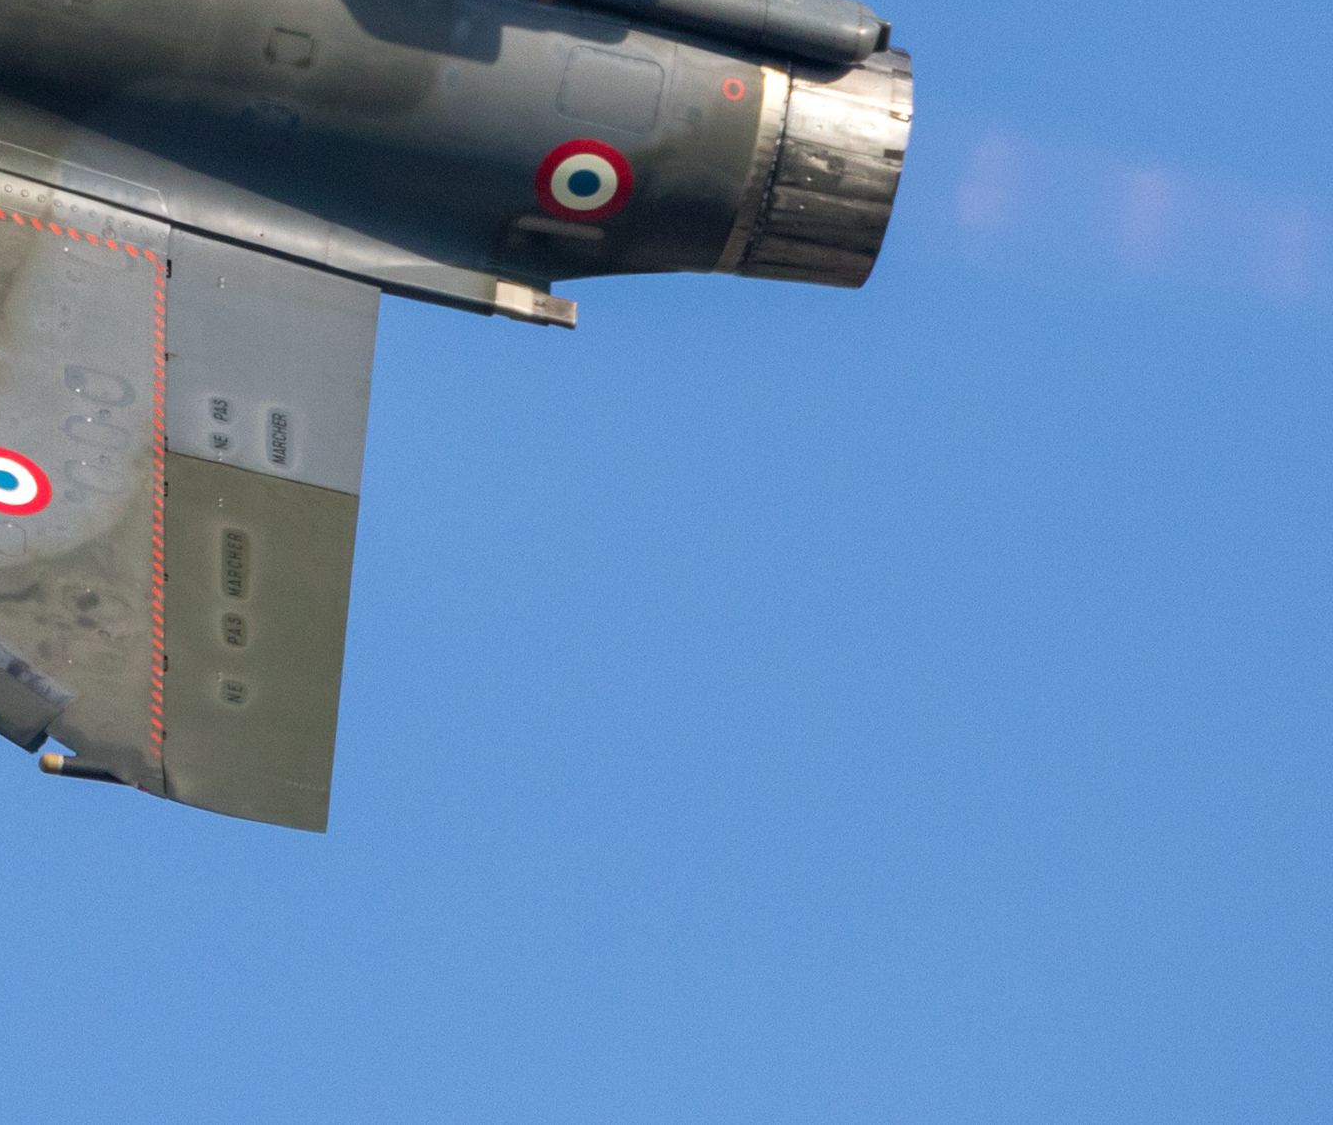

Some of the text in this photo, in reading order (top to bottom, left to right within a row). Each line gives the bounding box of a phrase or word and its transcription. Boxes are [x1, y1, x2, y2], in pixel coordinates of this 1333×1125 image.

[213, 397, 229, 450] NE PAS
[271, 411, 288, 465] MARCHER
[227, 531, 244, 704] NE PAS MARCHER
